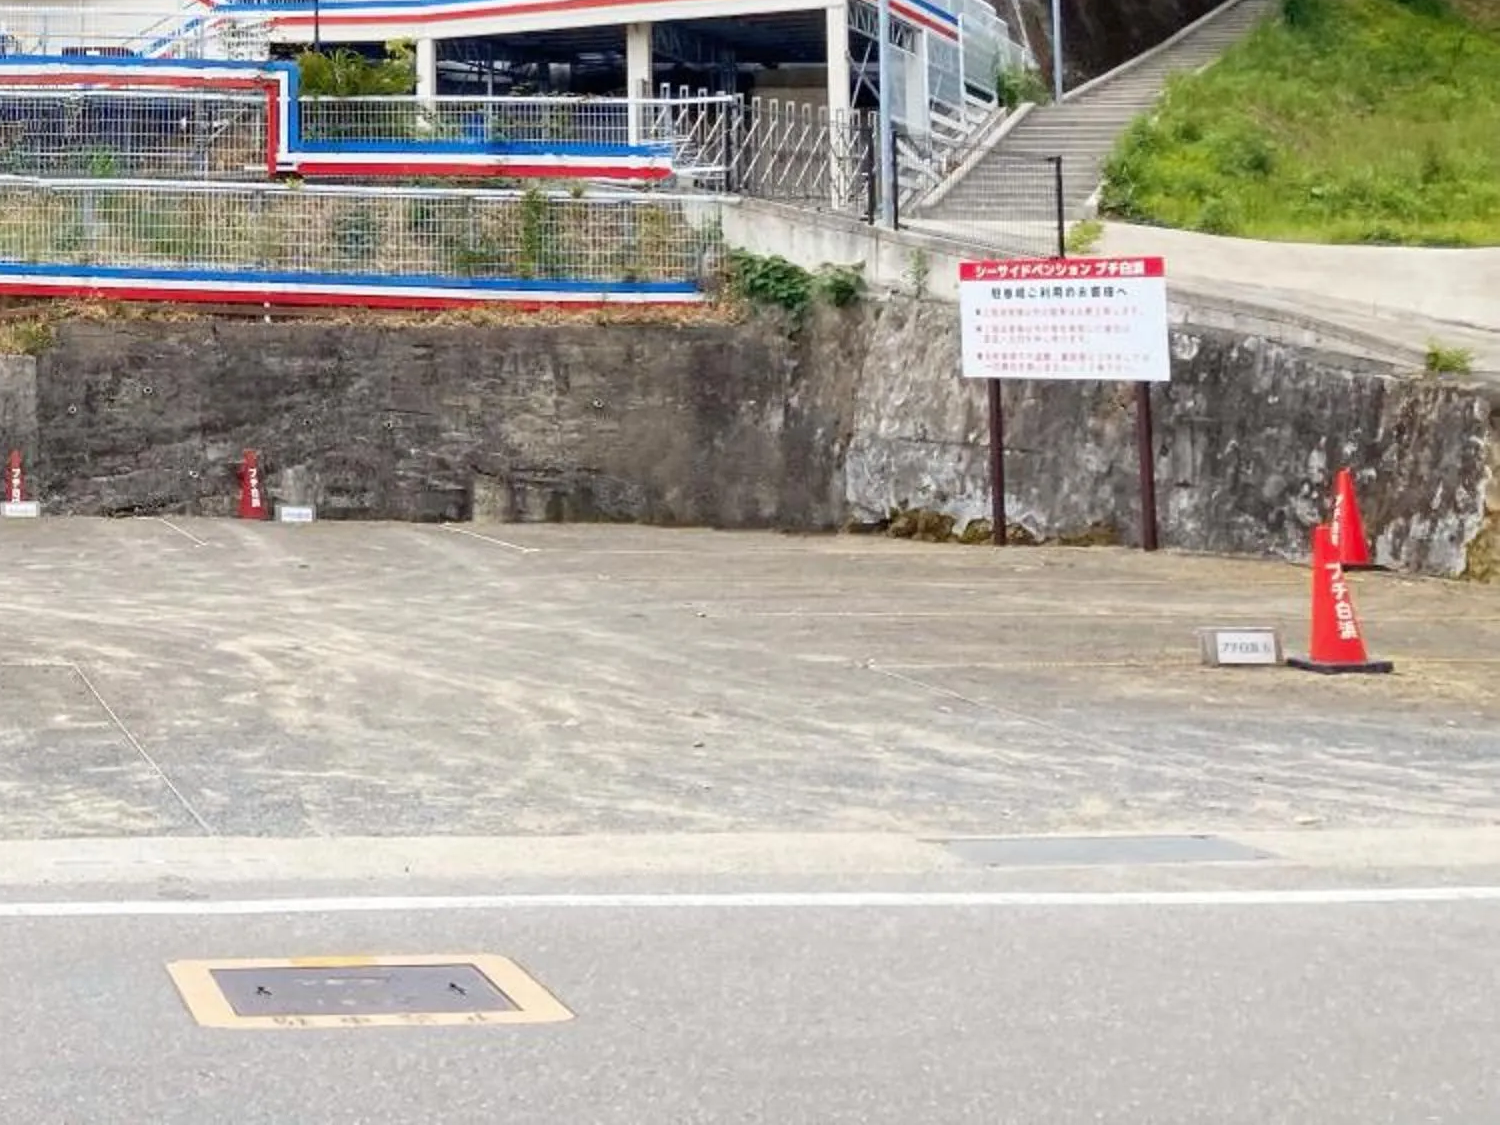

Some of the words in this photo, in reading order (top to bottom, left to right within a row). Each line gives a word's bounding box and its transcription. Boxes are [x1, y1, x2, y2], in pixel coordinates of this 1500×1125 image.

[975, 263, 1091, 277] シーサイドペンション
[1325, 562, 1358, 640] プチ白浜
